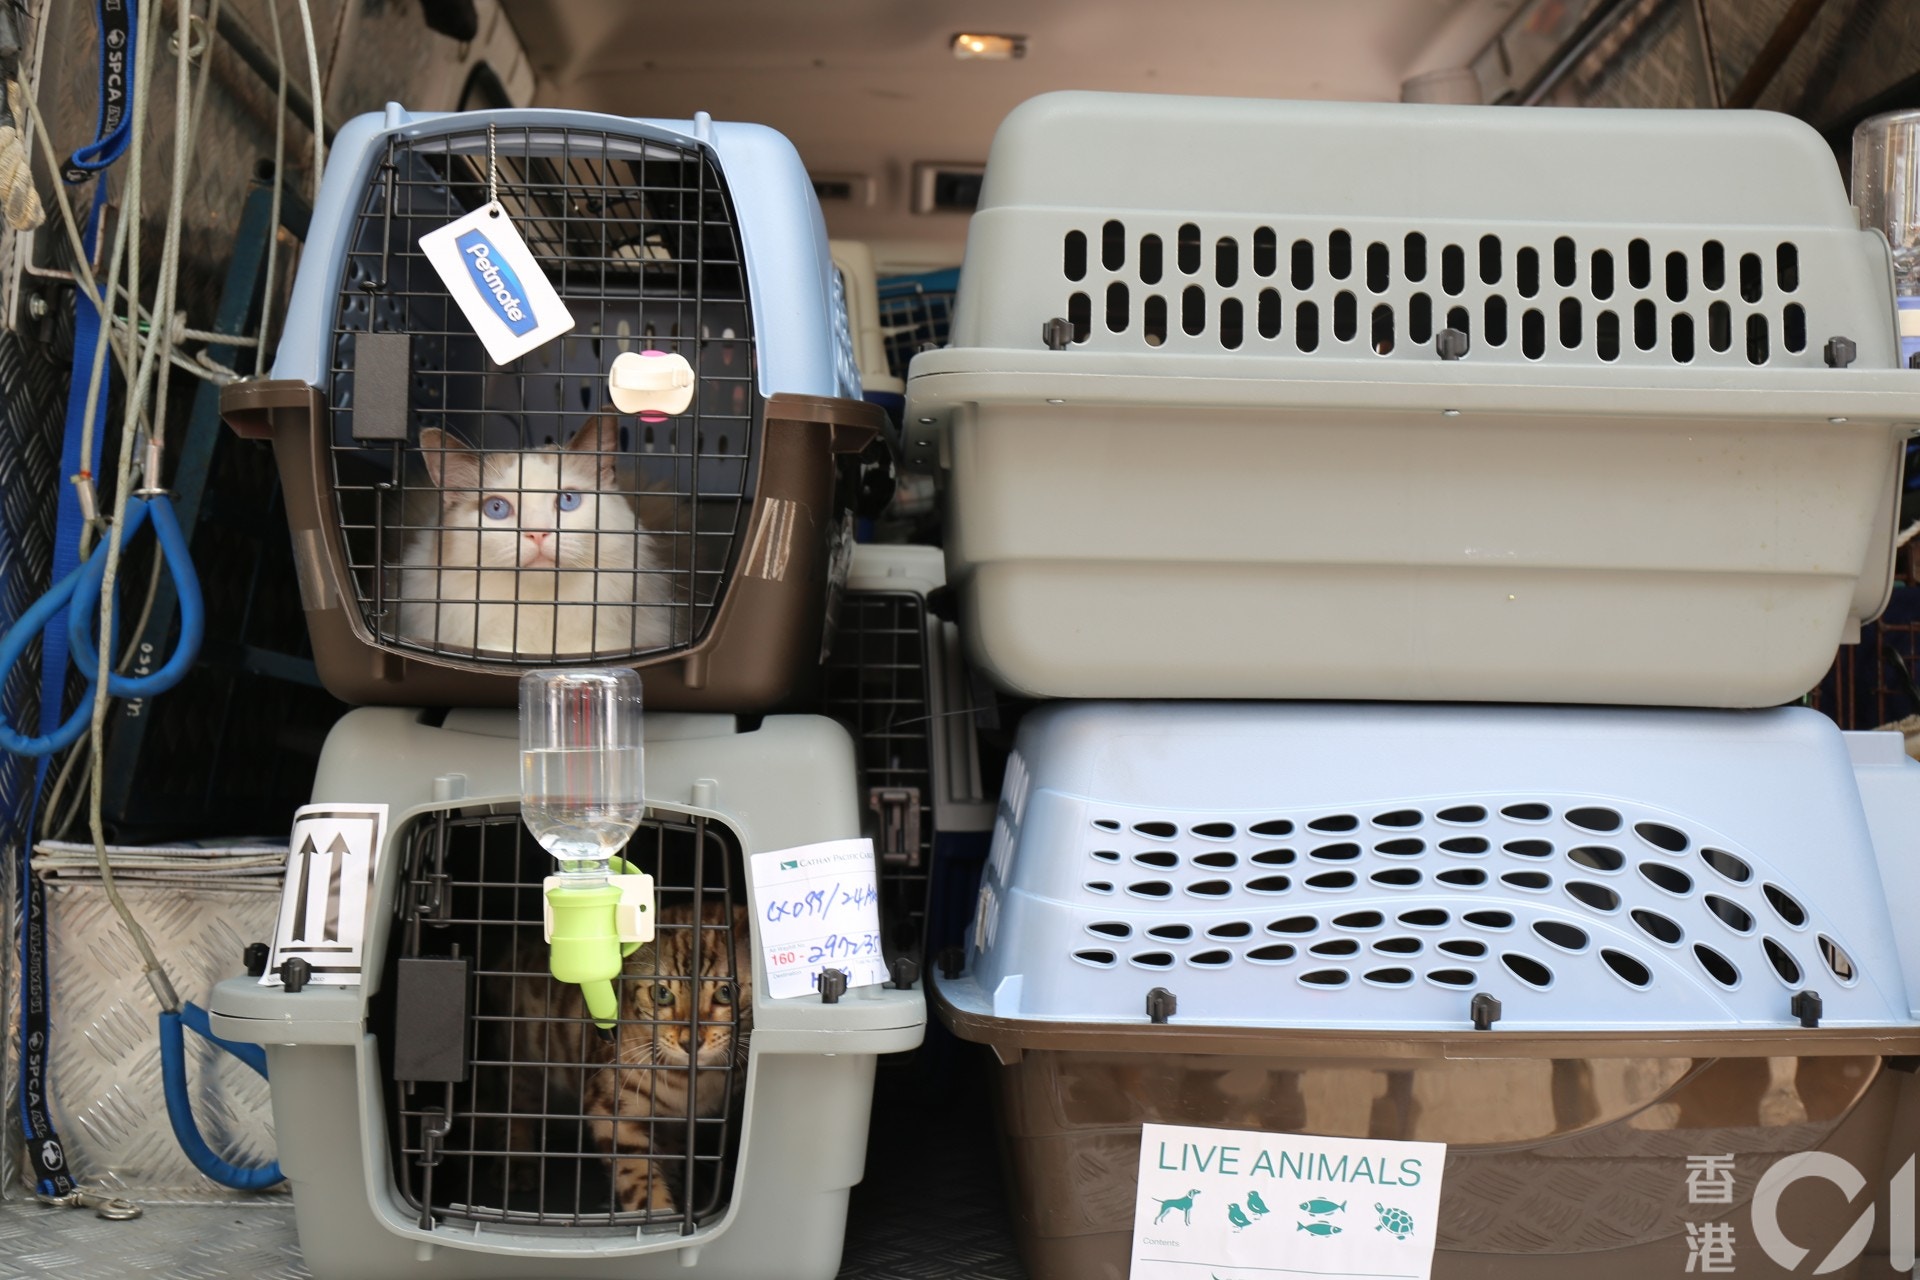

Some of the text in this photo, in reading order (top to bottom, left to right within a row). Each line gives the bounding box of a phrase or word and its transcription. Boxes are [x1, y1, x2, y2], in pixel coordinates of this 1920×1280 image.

[107, 51, 122, 102] SPCA
[466, 243, 524, 322] Petmate
[799, 856, 831, 868] CATHAY
[833, 853, 859, 863] PACIFIC
[771, 951, 796, 966] 160
[28, 1055, 41, 1107] SPCA
[1158, 1140, 1423, 1187] LIVE ANIMALS
[1142, 1236, 1181, 1248] Contents
